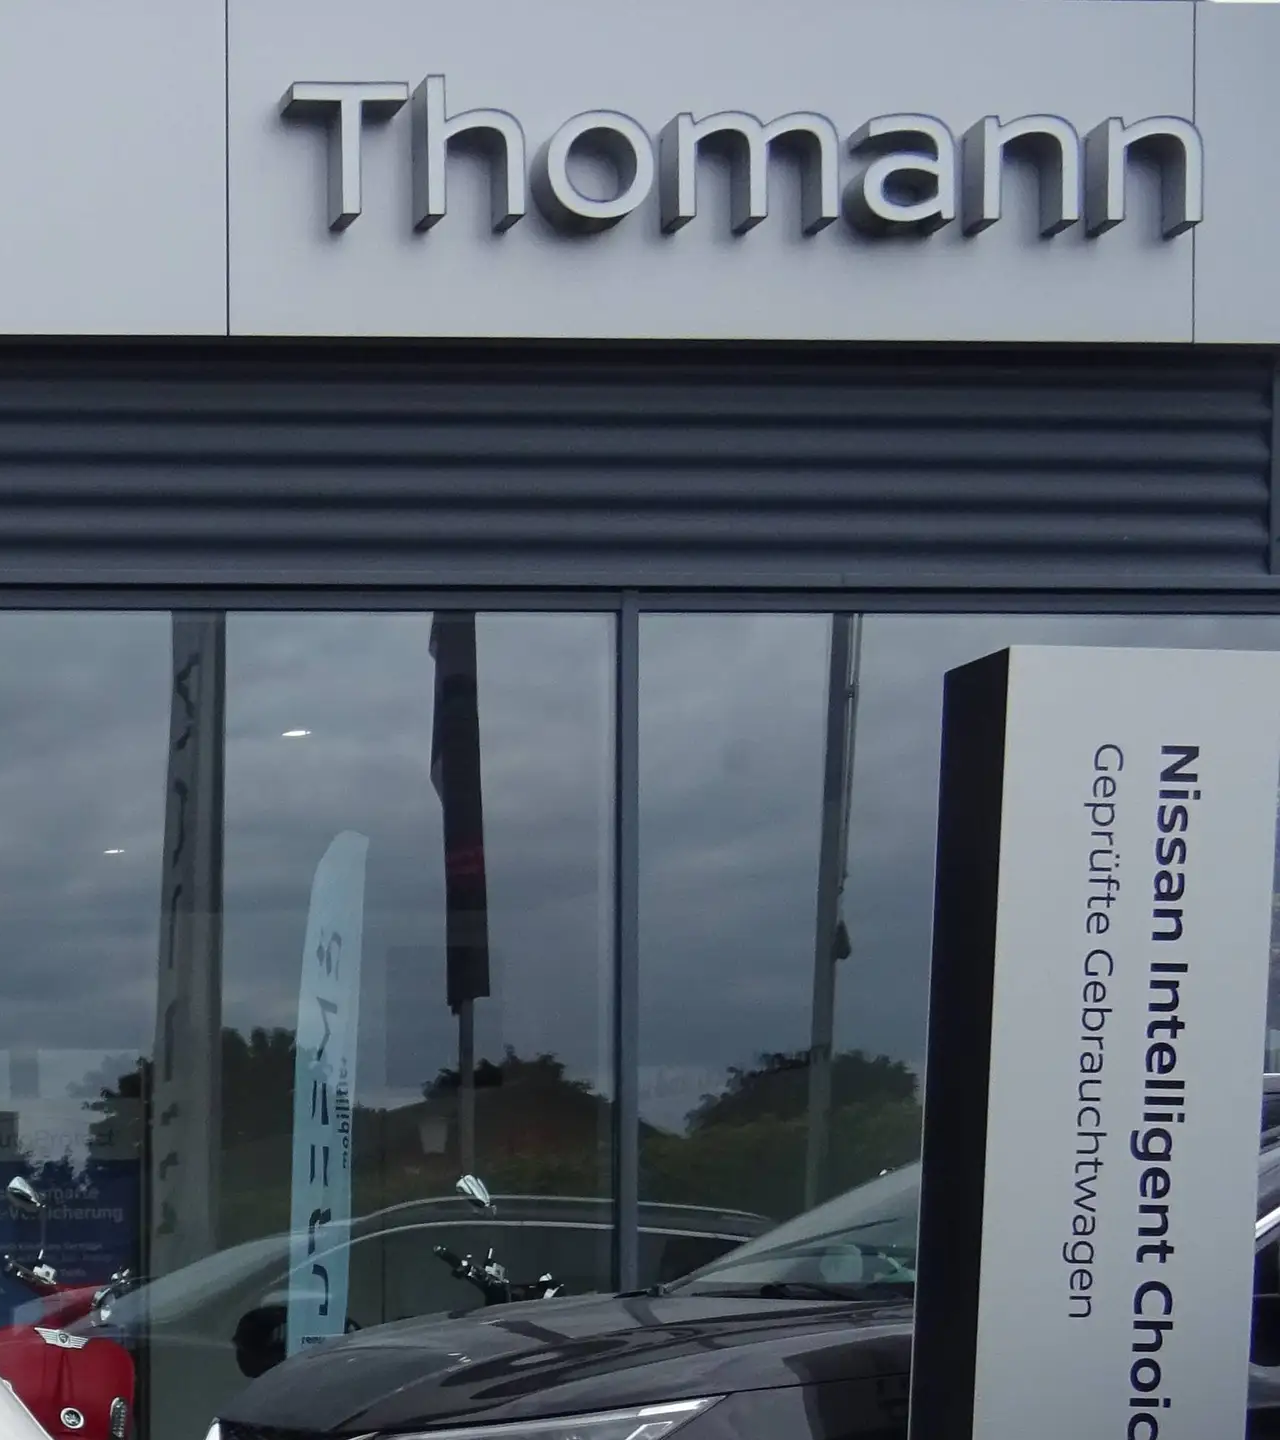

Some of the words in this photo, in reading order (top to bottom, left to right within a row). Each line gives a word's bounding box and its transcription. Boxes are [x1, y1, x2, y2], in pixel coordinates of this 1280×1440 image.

[280, 74, 1204, 240] Thomann
[1082, 743, 1124, 934] Geprüfte
[1150, 745, 1200, 941] Nissan
[1062, 948, 1115, 1320] Gebrauchtwagen
[1130, 962, 1189, 1264] Intelligent
